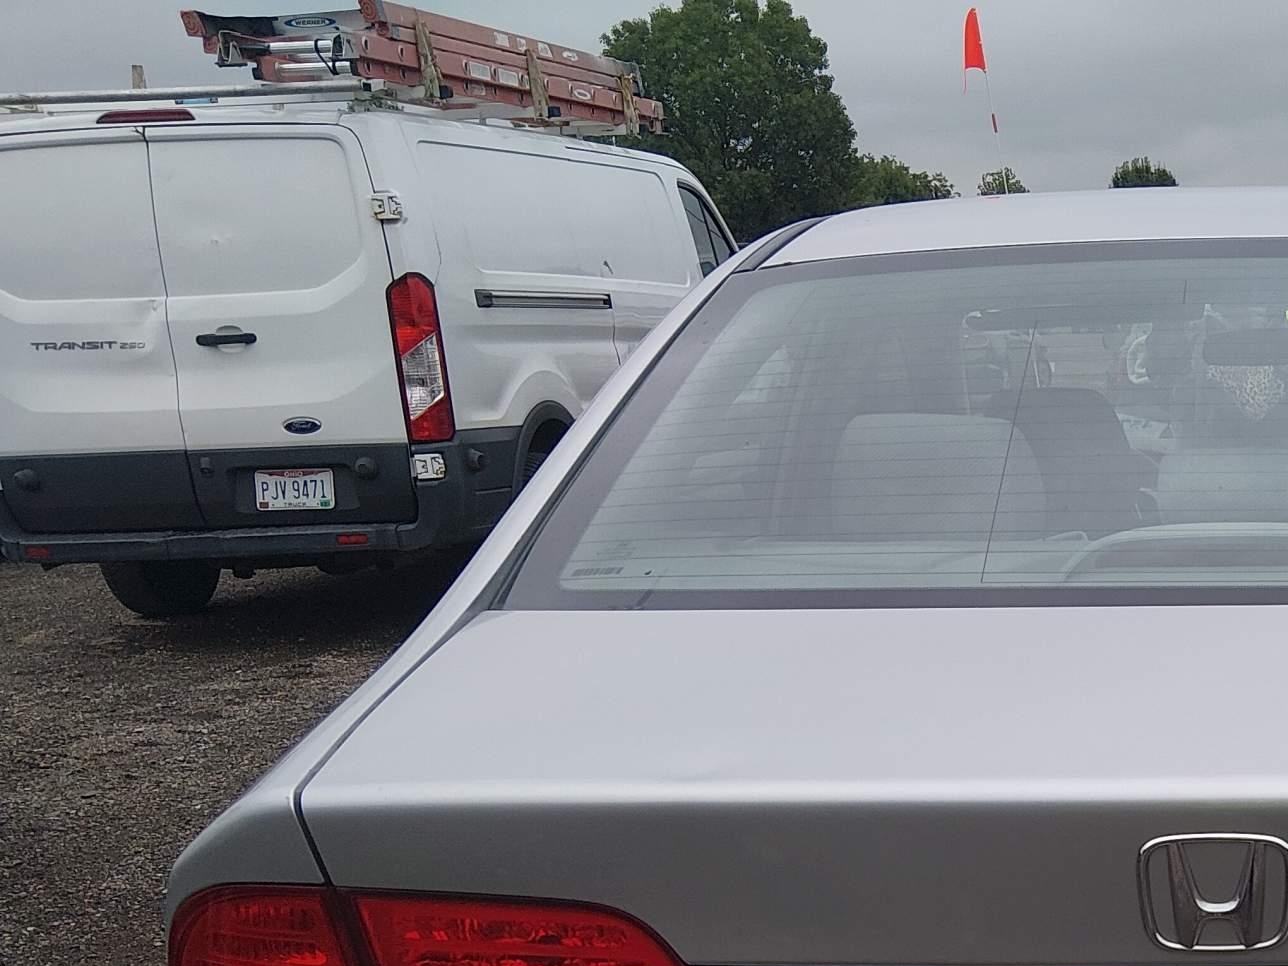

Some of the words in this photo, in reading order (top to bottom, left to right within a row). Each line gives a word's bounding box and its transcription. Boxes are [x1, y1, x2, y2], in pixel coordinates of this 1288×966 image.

[30, 341, 118, 351] TRANSIT
[119, 342, 146, 350] 250
[261, 480, 287, 500] PJV
[292, 479, 328, 499] 9471
